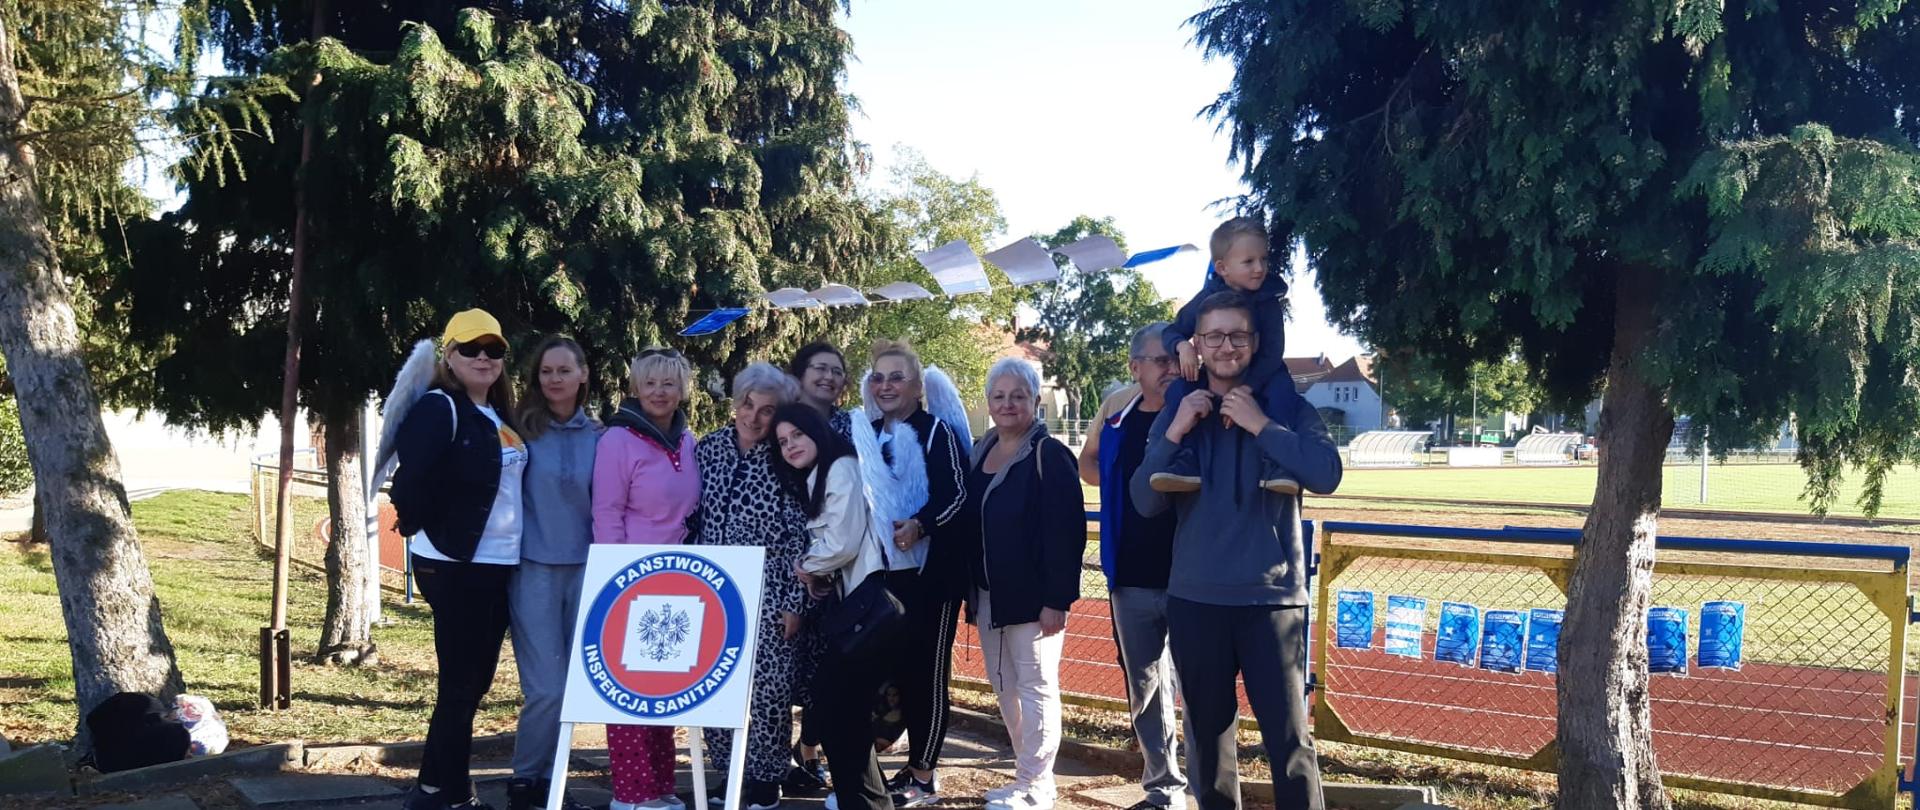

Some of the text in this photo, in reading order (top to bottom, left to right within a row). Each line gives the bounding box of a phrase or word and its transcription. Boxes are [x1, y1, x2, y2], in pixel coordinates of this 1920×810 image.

[614, 555, 726, 591] PAŃSTWOWA
[584, 643, 740, 714] INSPEKCJA SANITARNA
